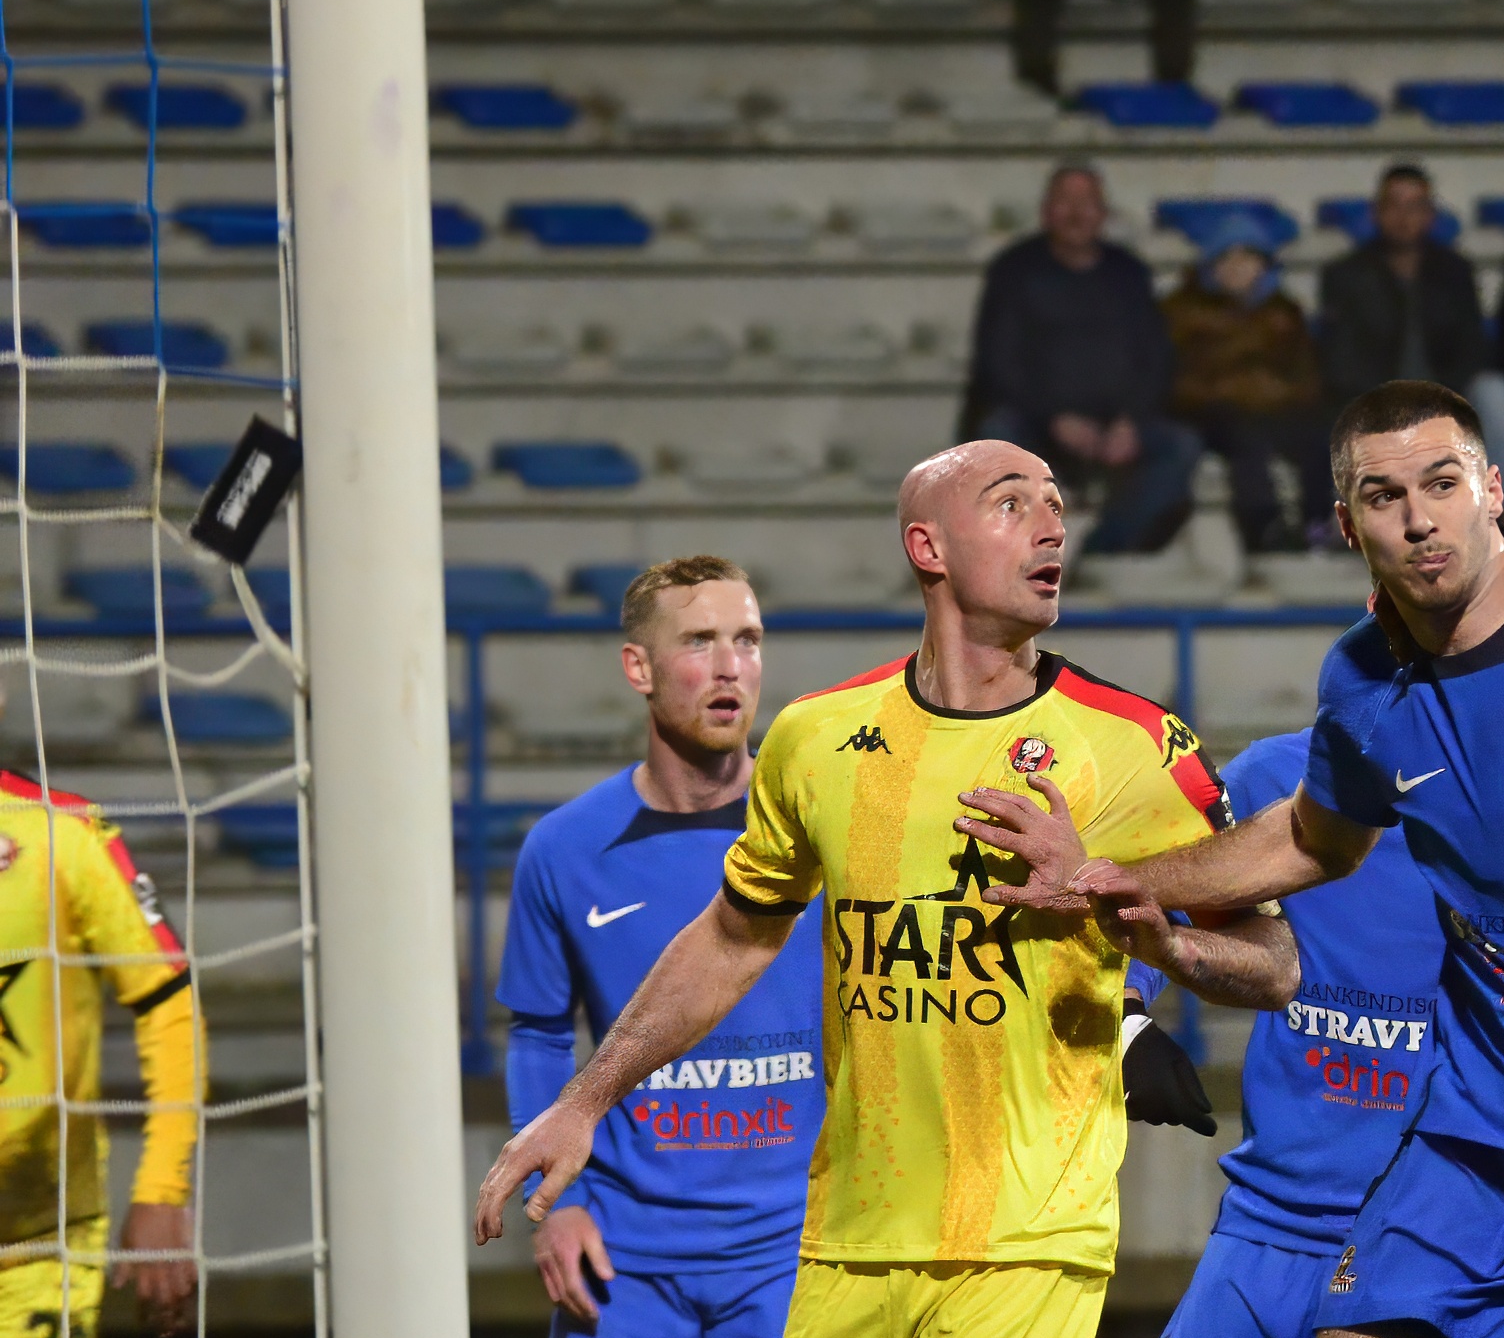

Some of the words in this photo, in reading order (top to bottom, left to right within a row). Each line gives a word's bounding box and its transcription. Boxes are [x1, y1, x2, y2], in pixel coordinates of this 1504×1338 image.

[834, 898, 996, 982] STAR
[636, 1051, 815, 1090] RAVBIER
[652, 1097, 794, 1140] drinxit
